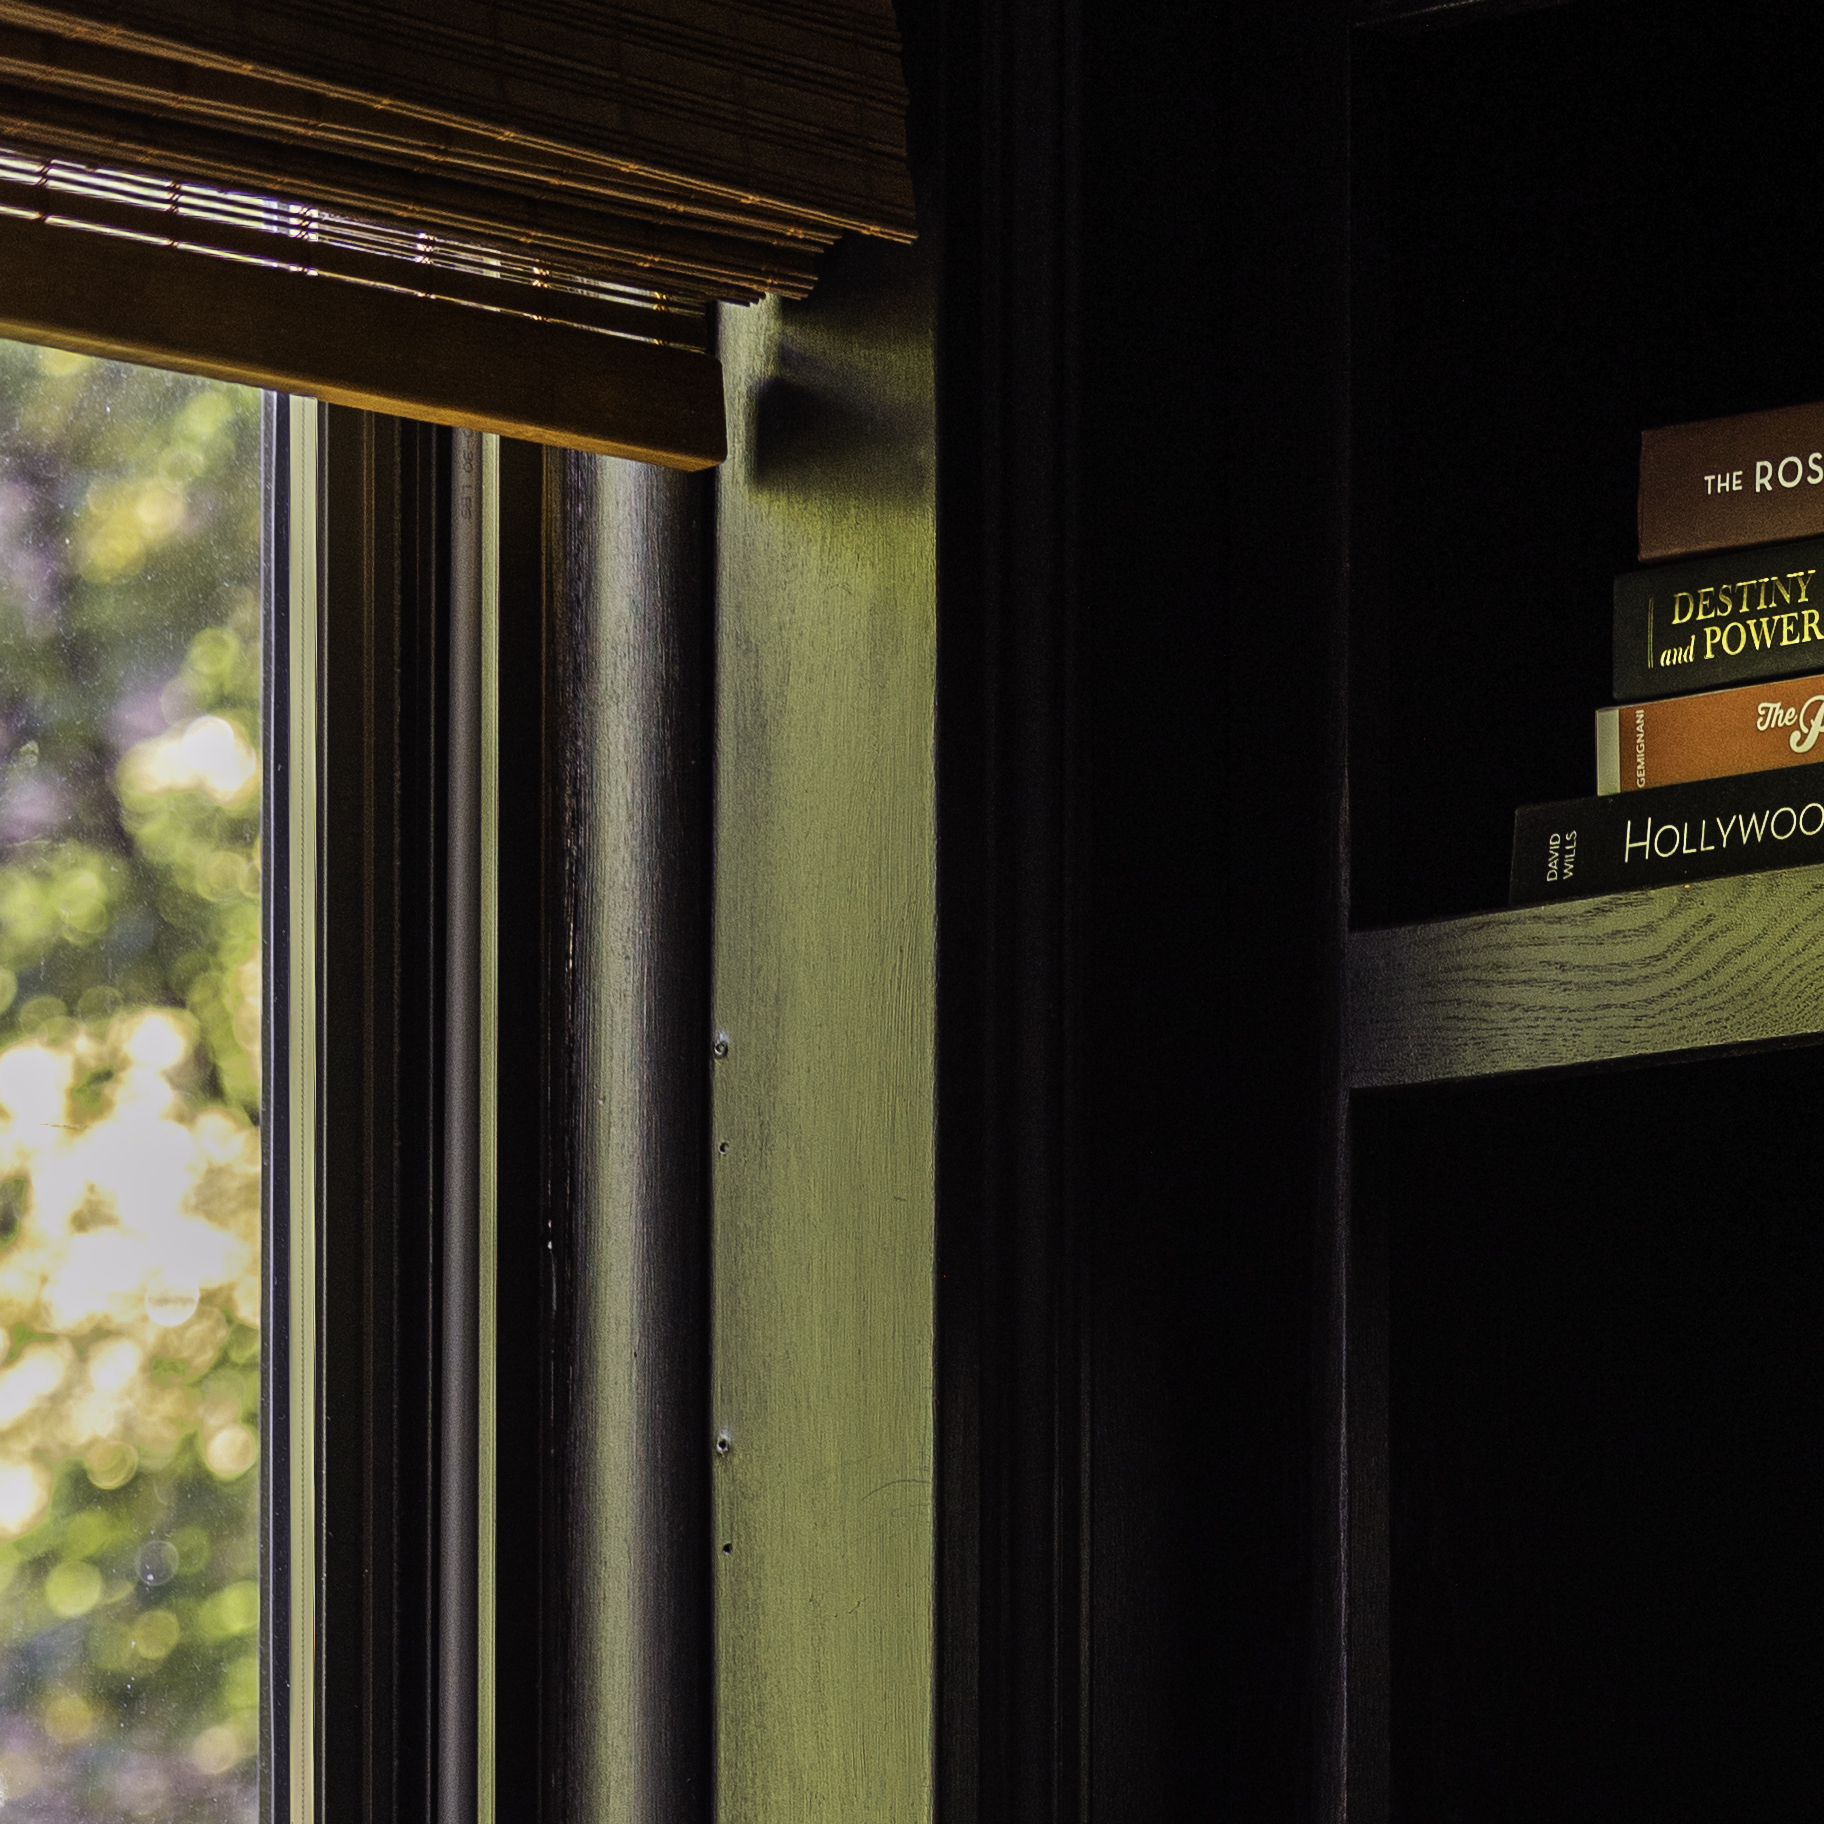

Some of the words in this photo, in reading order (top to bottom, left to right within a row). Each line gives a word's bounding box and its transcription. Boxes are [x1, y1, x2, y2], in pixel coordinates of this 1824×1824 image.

[1704, 471, 1743, 495] THE
[1672, 569, 1817, 625] DESTINY
[1660, 634, 1696, 667] and
[1757, 702, 1798, 731] The
[1635, 709, 1646, 789] GEMIGNANI
[1546, 833, 1562, 881] DAVID
[1562, 830, 1578, 879] WILLS
